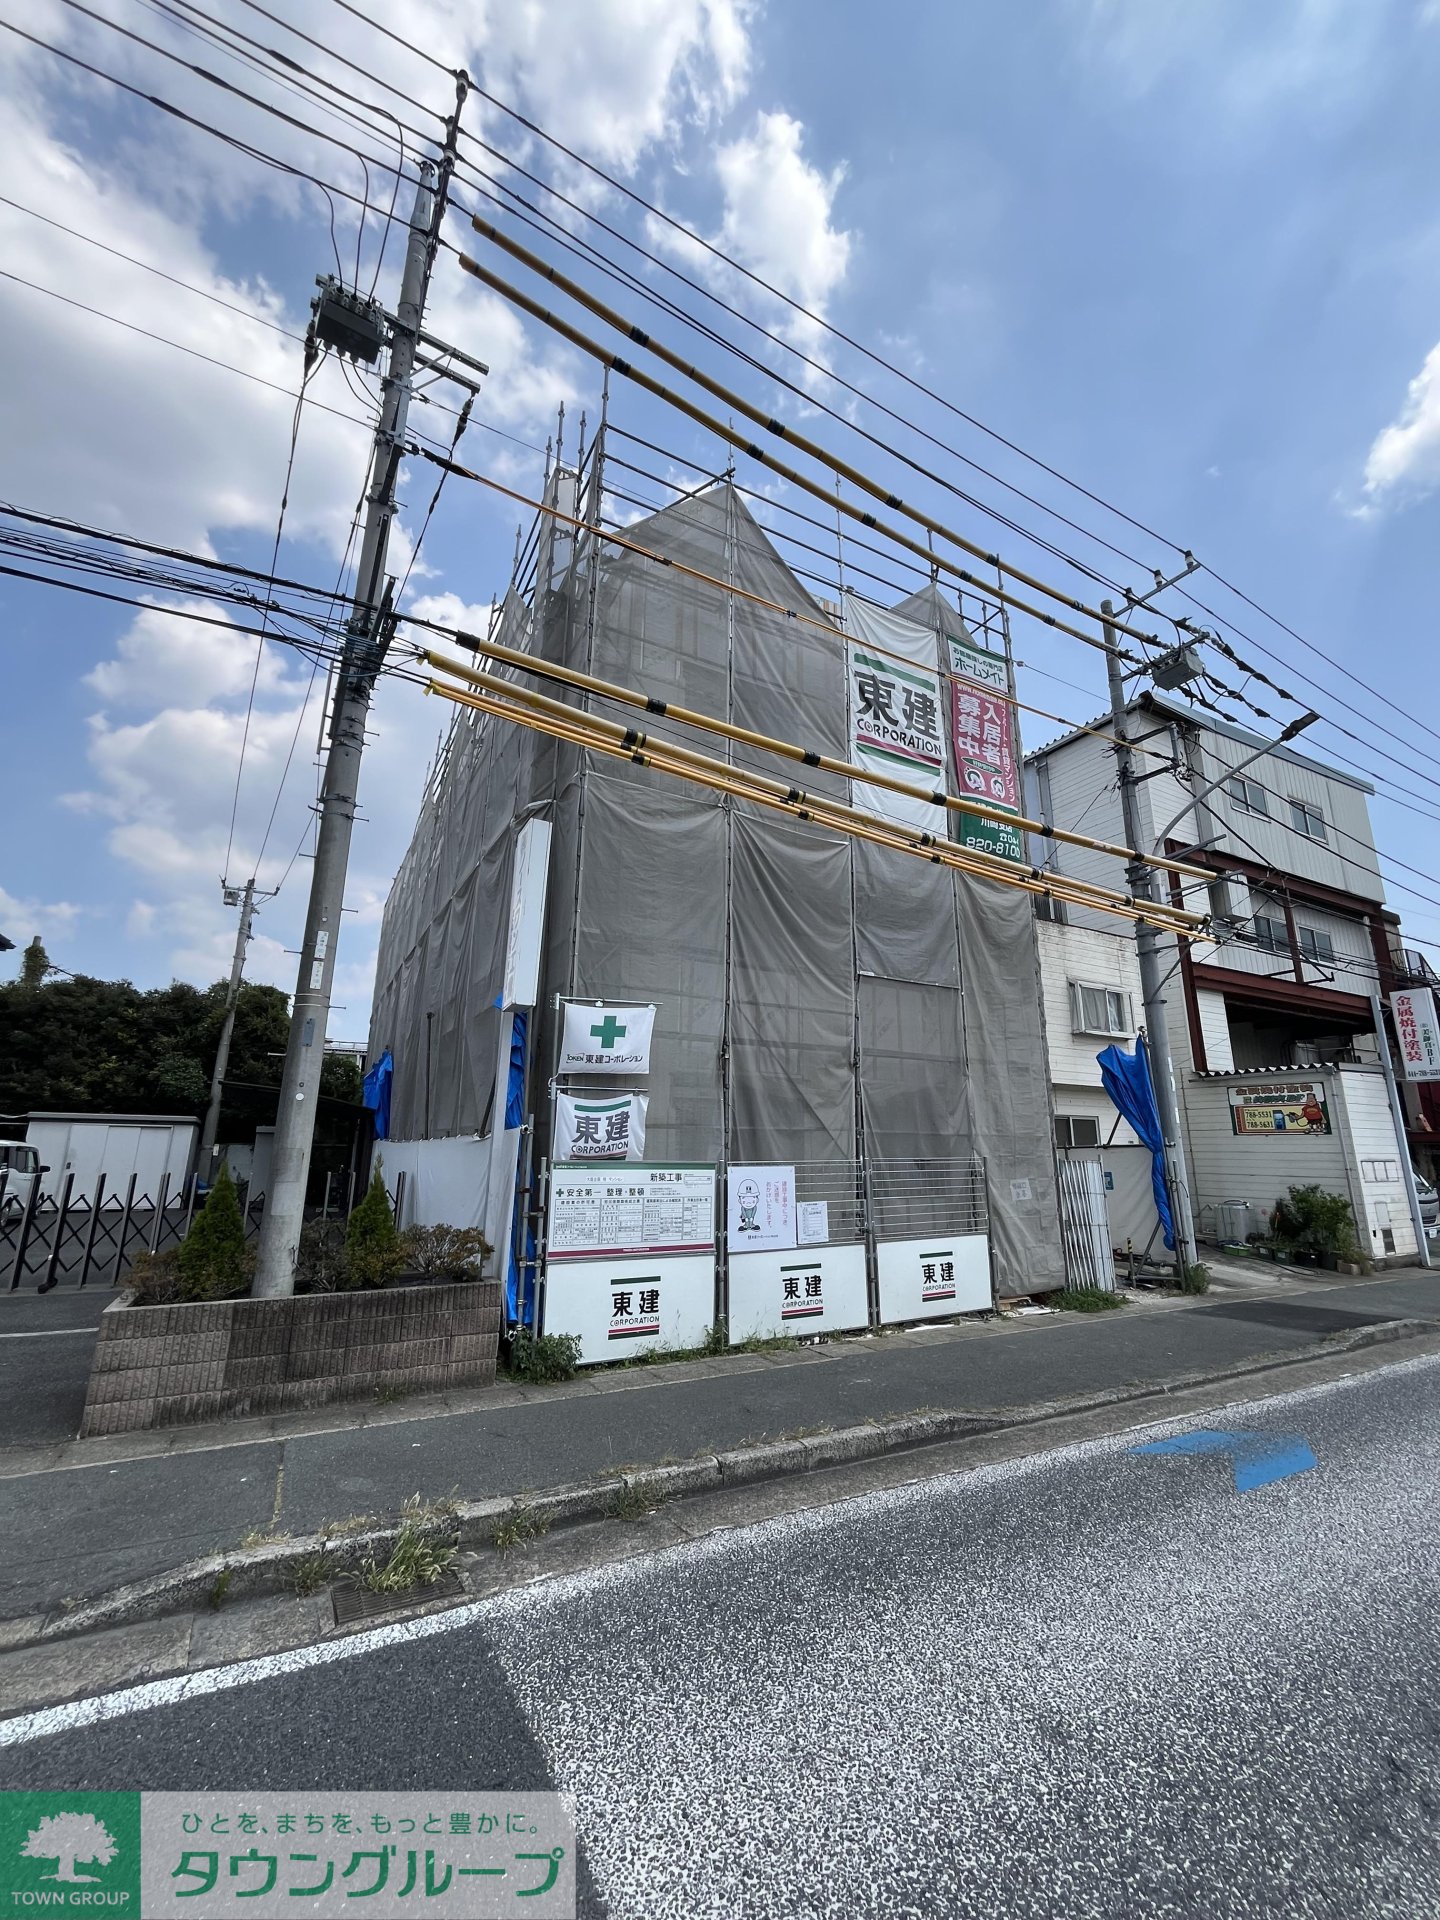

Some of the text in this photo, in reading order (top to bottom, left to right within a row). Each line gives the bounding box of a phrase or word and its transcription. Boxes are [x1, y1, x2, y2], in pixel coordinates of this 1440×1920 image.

[955, 657, 1004, 686] ホームメイト
[854, 670, 940, 741] 東建
[856, 718, 942, 756] CORPORATION
[958, 693, 980, 756] 募集中
[981, 702, 1001, 765] 入居者
[966, 836, 1020, 858] 820-8100
[1396, 996, 1423, 1061] 金属焼付塗装
[585, 1054, 643, 1064] 東建コーポレーション
[571, 1110, 630, 1144] 東建
[571, 1140, 629, 1154] CORPORATION
[650, 1172, 682, 1182] 新築工事
[566, 1188, 602, 1197] 安全第一
[606, 1187, 645, 1197] 整理・整頓
[921, 1261, 955, 1285] 東建
[782, 1274, 823, 1301] 東建
[611, 1288, 660, 1318] 東建
[781, 1298, 824, 1309] CORPORATION
[609, 1315, 660, 1327] CORPORATION
